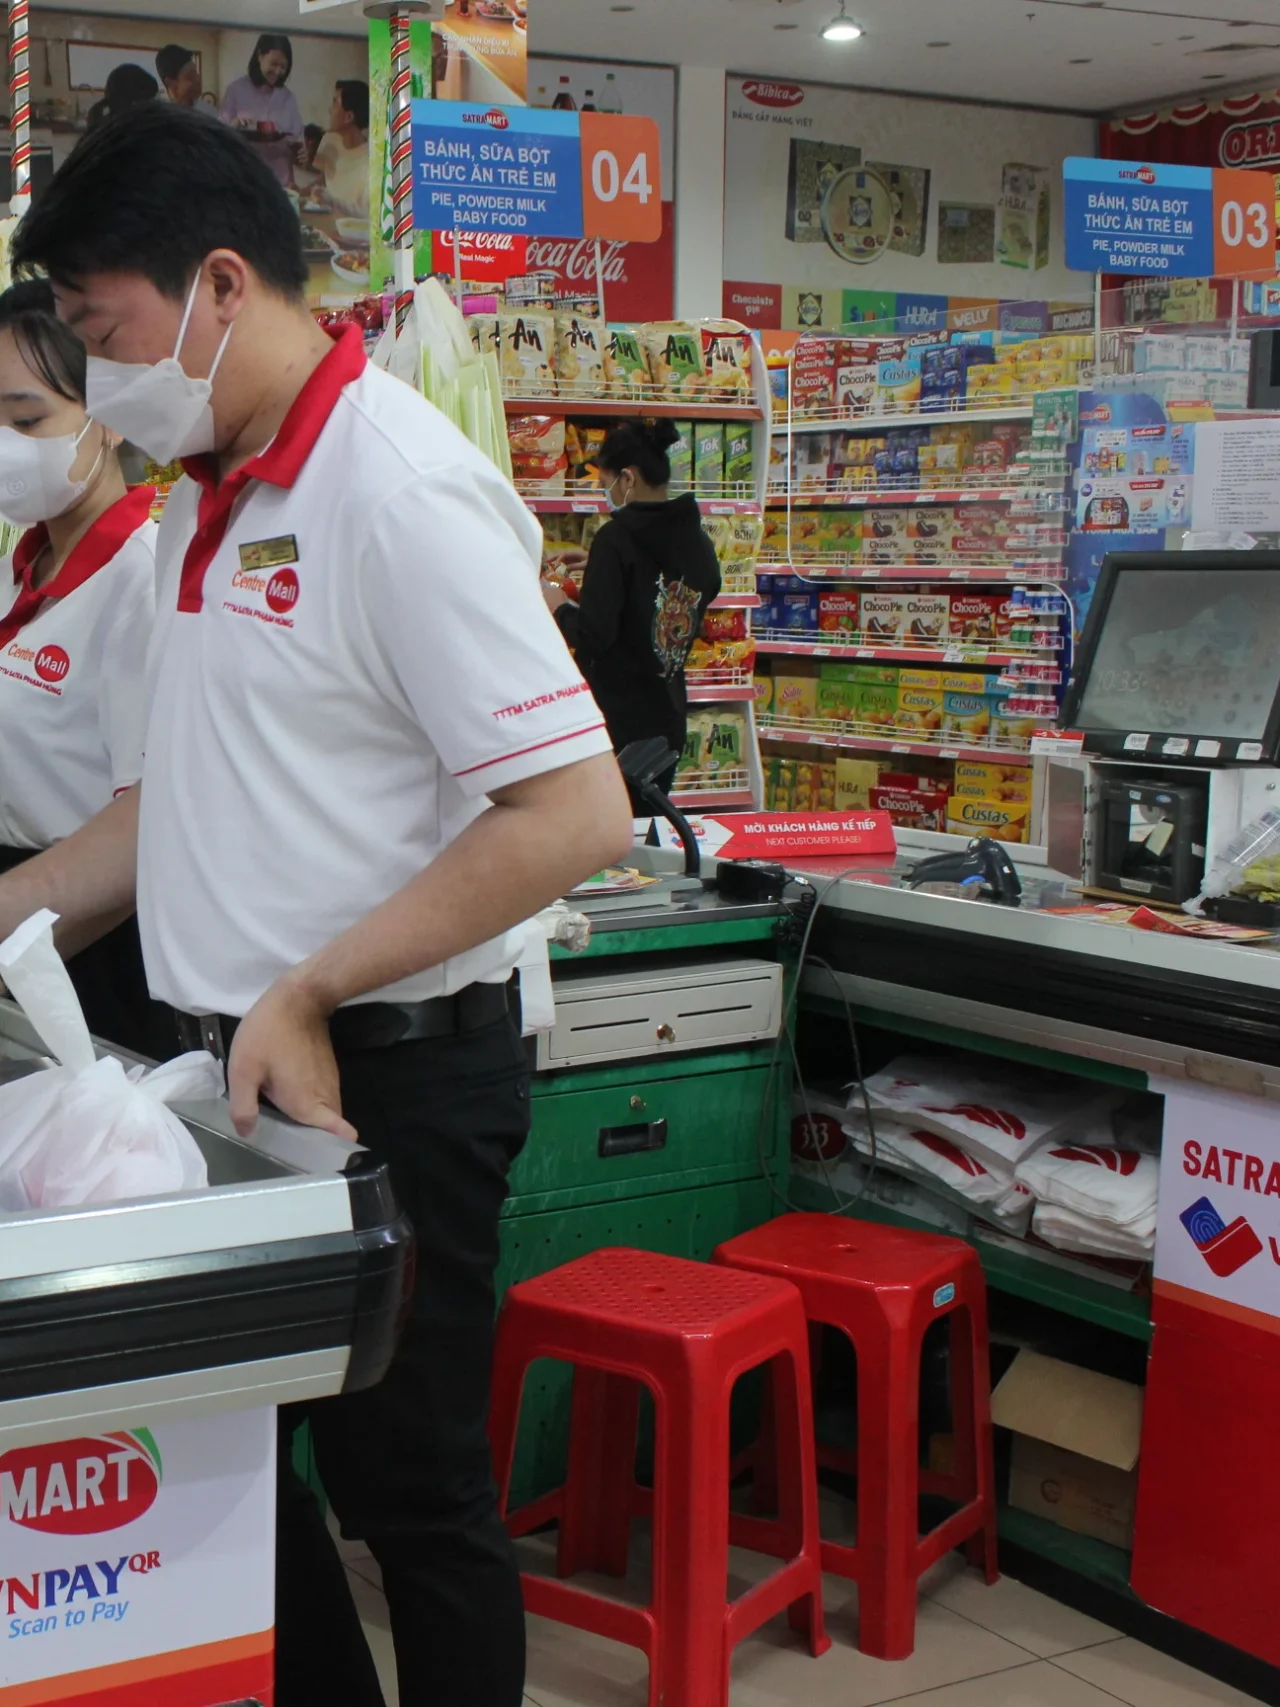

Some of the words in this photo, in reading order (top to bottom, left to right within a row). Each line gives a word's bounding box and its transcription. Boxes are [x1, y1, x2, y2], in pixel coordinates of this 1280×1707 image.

[756, 83, 791, 100] Bibica
[462, 112, 508, 128] SATRAMART
[424, 138, 475, 162] BÁNH,
[480, 143, 515, 162] SỮA
[518, 146, 550, 168] BỘT
[420, 161, 467, 182] THỨC
[471, 163, 494, 184] ĂN
[498, 166, 529, 187] TRẺ
[533, 171, 556, 188] EM
[591, 150, 652, 204] 04
[431, 192, 455, 208] PIE,
[458, 194, 515, 211] POWDER
[517, 198, 547, 212] MILK
[1088, 192, 1129, 213] BÁNH,
[1132, 195, 1159, 212] SỮA
[1163, 199, 1189, 217] BỘT
[453, 210, 488, 225] BABY
[491, 212, 527, 227] FOOD
[1084, 212, 1121, 231] THỨC
[1124, 213, 1143, 231] ĂN
[1146, 214, 1171, 233] TRẺ
[1174, 219, 1193, 234] EM
[1221, 200, 1269, 248] 03
[1093, 238, 1111, 252] PIE,
[1114, 240, 1158, 255] POWDER
[1161, 243, 1185, 256] MILK
[1110, 254, 1137, 267] BABY
[1140, 255, 1169, 268] FOOD
[732, 293, 774, 306] Chocolate
[904, 304, 937, 326] HURA
[952, 307, 990, 328] WELLY
[269, 579, 296, 602] Mall
[37, 652, 67, 675] Mall
[492, 704, 523, 720] TTTM
[523, 693, 556, 711] SATRA
[903, 693, 936, 706] Custas
[948, 696, 984, 711] Custas
[878, 796, 925, 813] ChocoPie
[962, 803, 1009, 824] Custas
[744, 820, 766, 833] MỜI
[768, 819, 806, 833] KHÁCH
[809, 818, 839, 832] HÀNG
[842, 816, 856, 831] KẾ
[856, 815, 877, 830] TIẾP
[766, 837, 785, 846] NEXT
[787, 835, 830, 846] CUSTOMER
[8, 1617, 56, 1639] Scan
[65, 1608, 85, 1627] to
[92, 1600, 130, 1625] Pay
